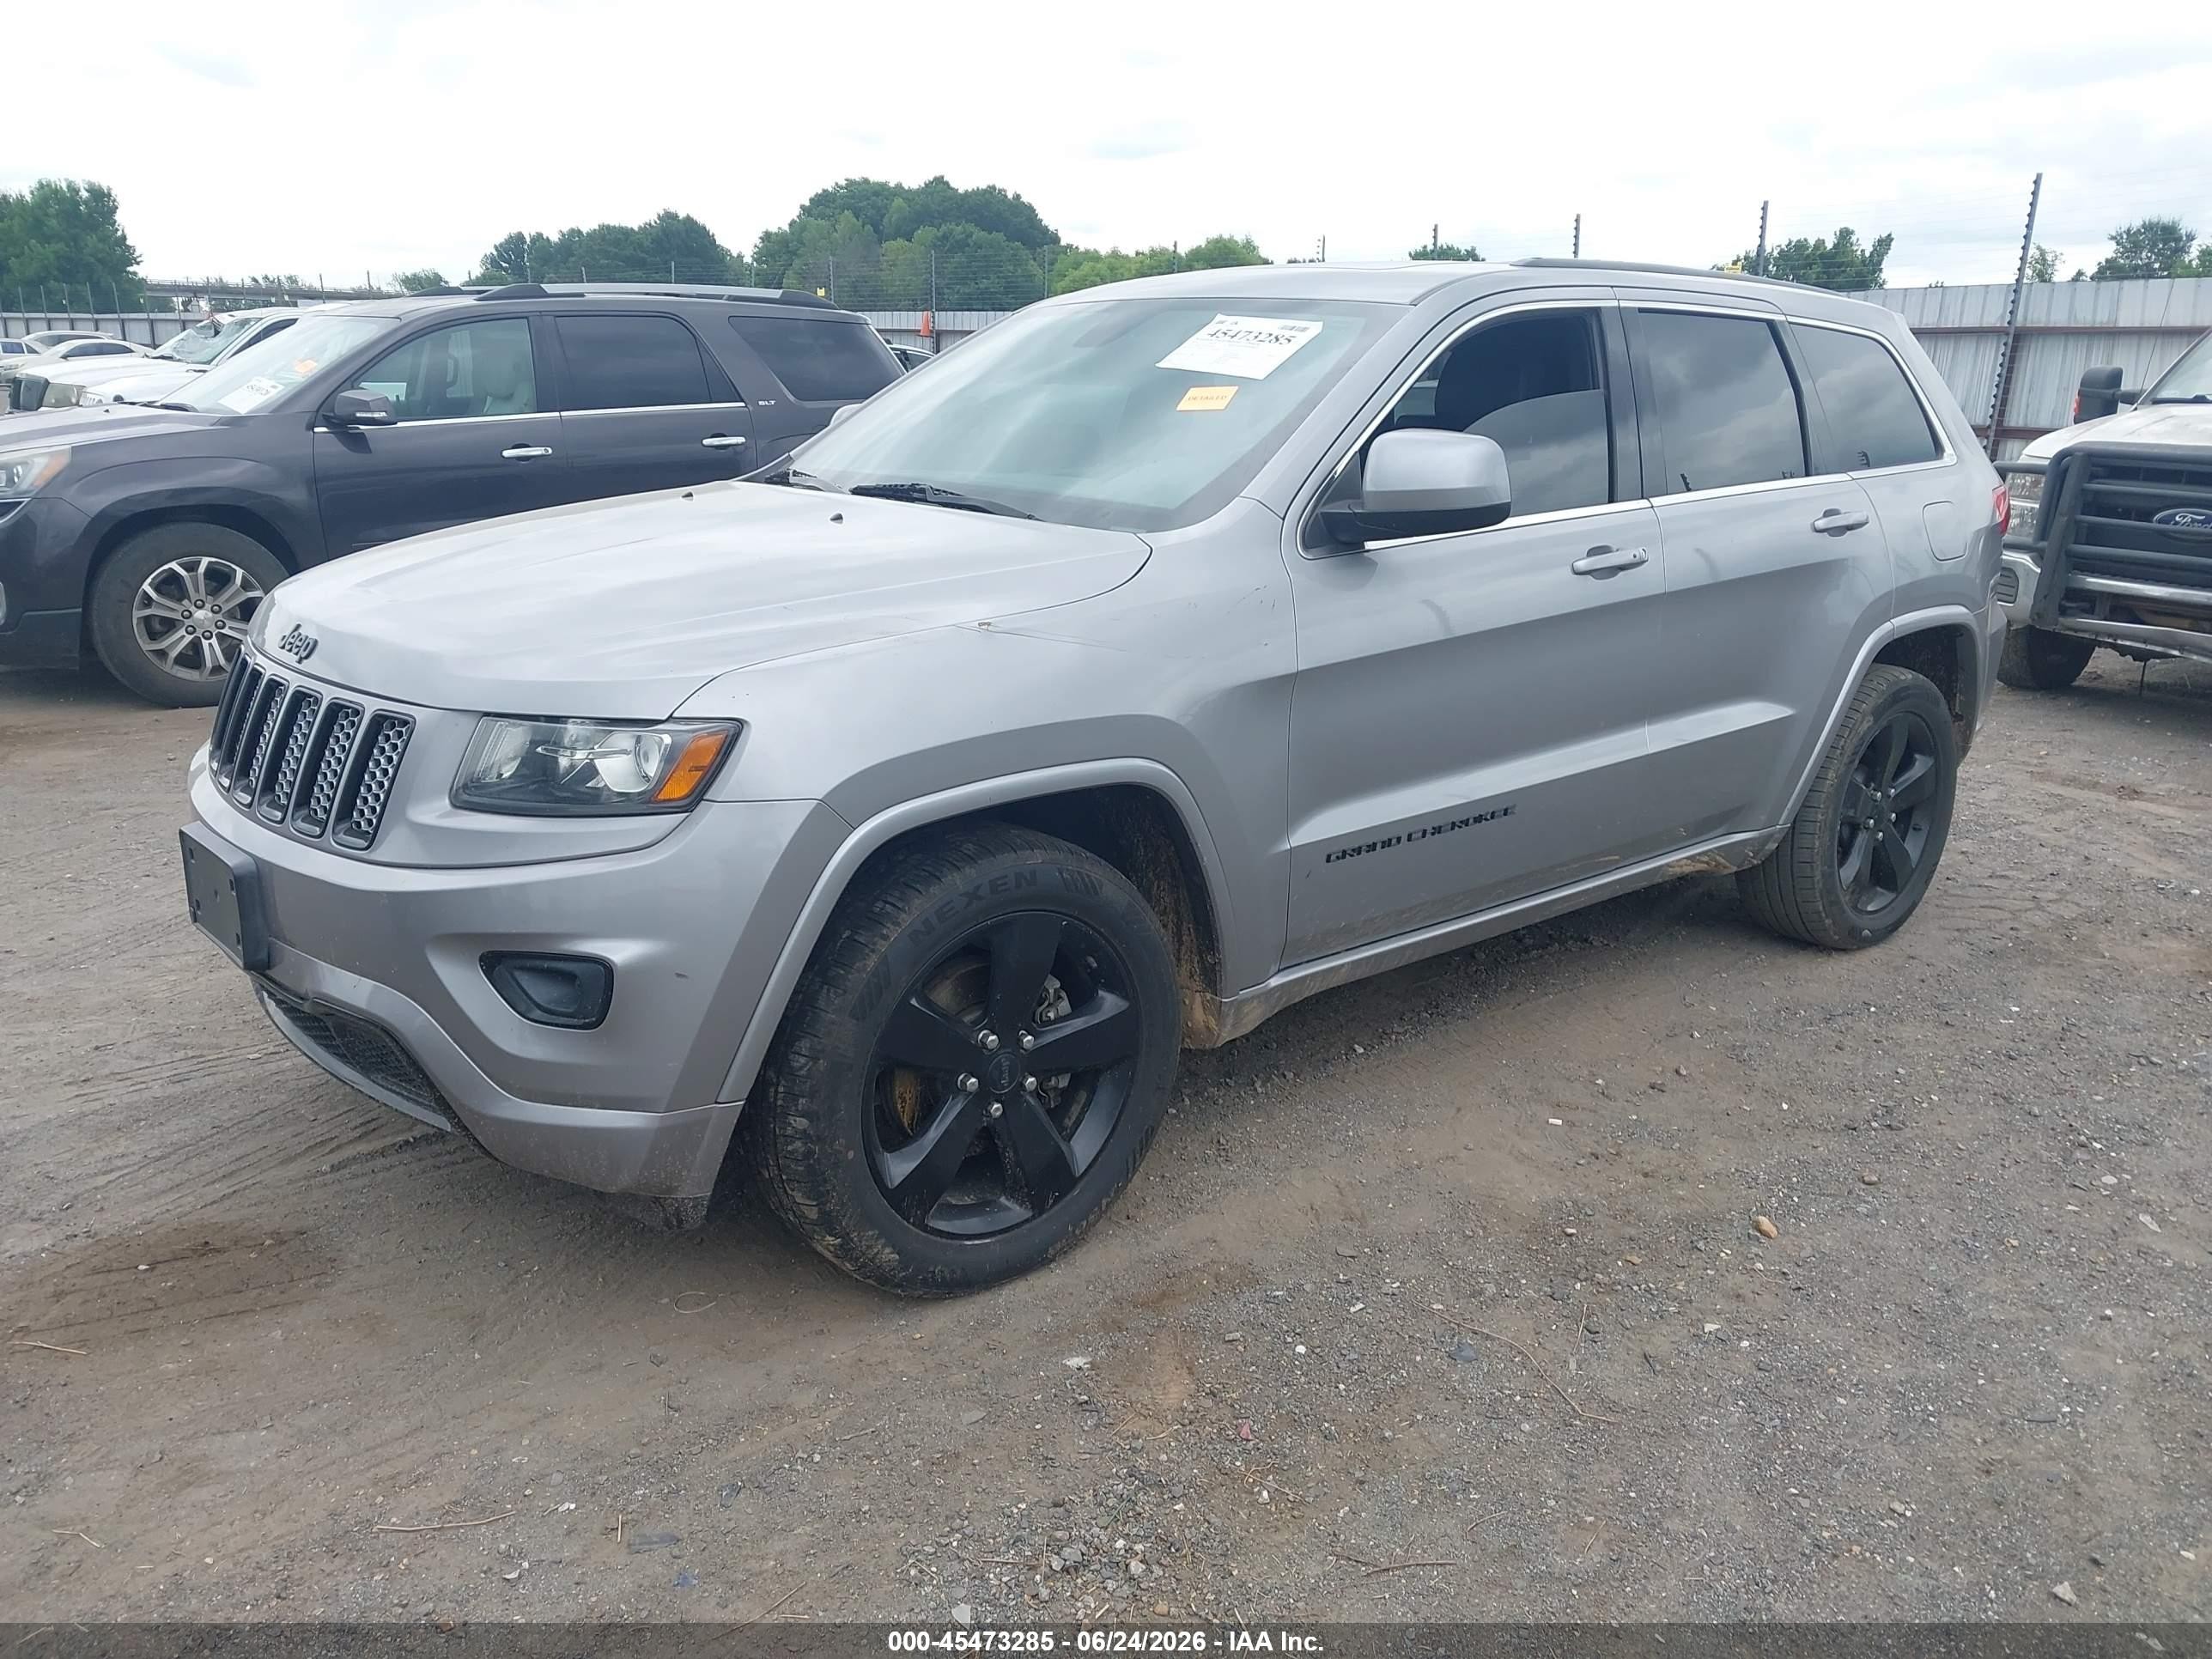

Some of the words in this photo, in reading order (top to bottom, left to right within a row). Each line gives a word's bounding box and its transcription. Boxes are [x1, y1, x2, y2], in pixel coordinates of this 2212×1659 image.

[1207, 328, 1297, 345] 45473285
[278, 623, 318, 664] Jeep
[1326, 836, 1402, 863] GRAND
[1407, 804, 1516, 842] CHEROKEE
[907, 869, 1037, 945] NEXEN
